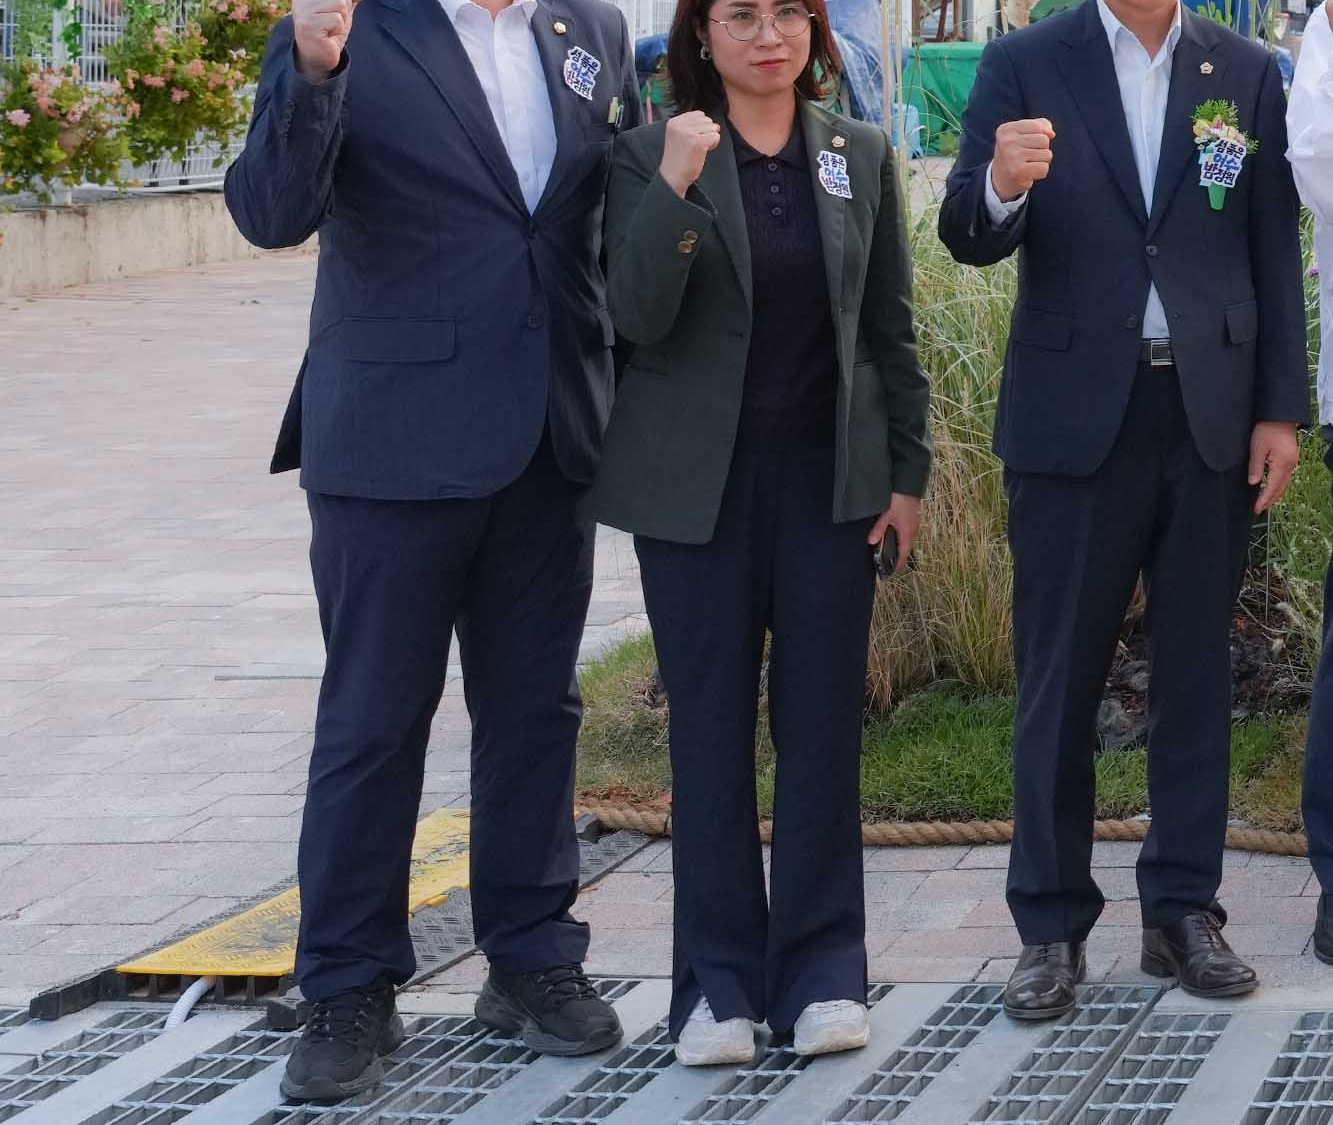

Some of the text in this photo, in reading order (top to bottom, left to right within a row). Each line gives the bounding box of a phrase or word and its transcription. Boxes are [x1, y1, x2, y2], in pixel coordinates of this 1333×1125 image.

[1214, 139, 1244, 160] 섬품은
[1212, 153, 1241, 171] 여수
[1203, 161, 1235, 186] 밤정원
